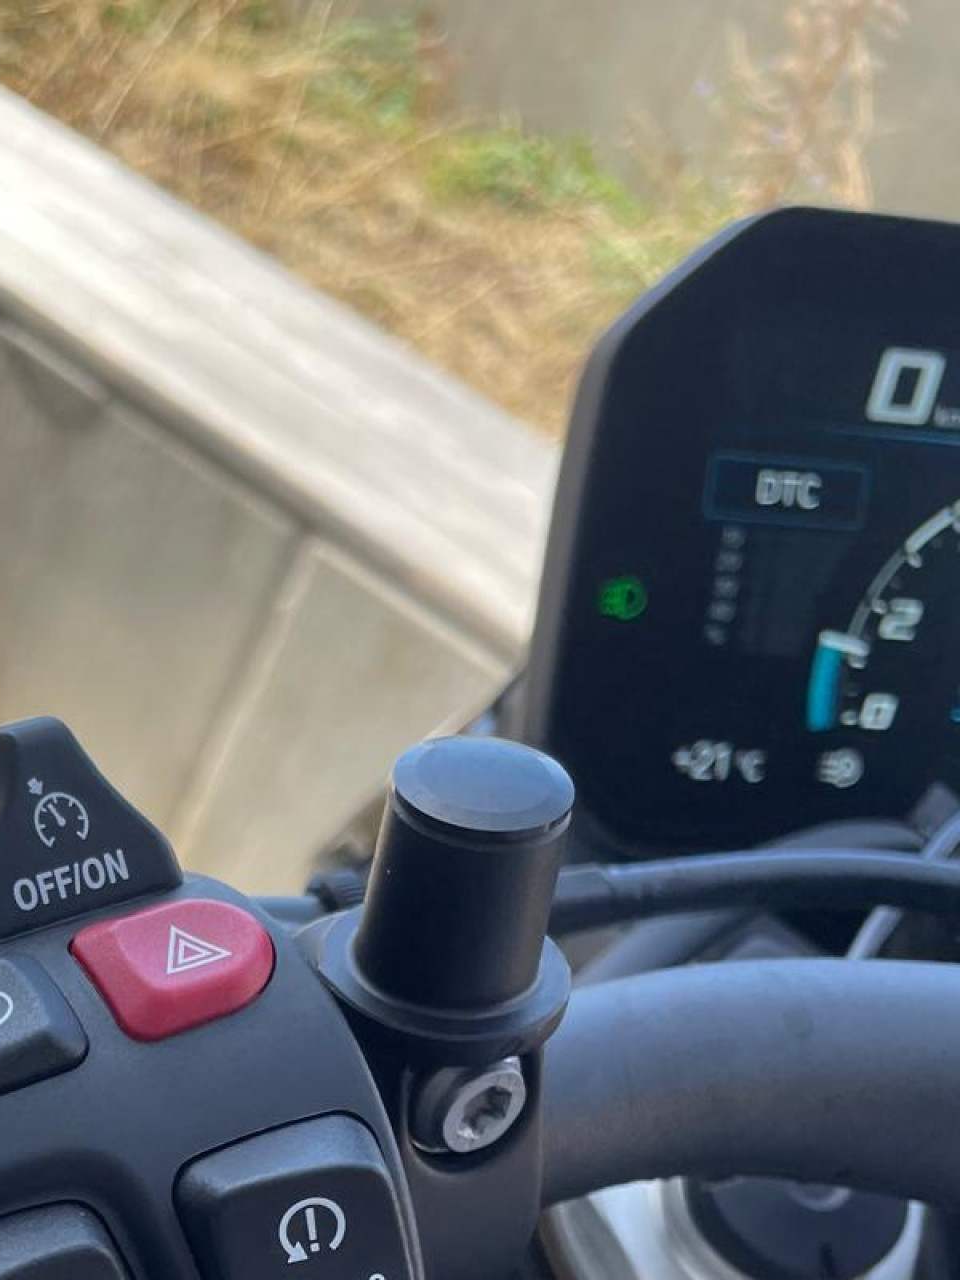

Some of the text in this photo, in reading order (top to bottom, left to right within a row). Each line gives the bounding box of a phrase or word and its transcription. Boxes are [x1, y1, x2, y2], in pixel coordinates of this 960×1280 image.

[866, 346, 946, 424] 0
[755, 469, 822, 509] DTC
[878, 598, 923, 641] 2
[13, 849, 129, 911] OFF/ON
